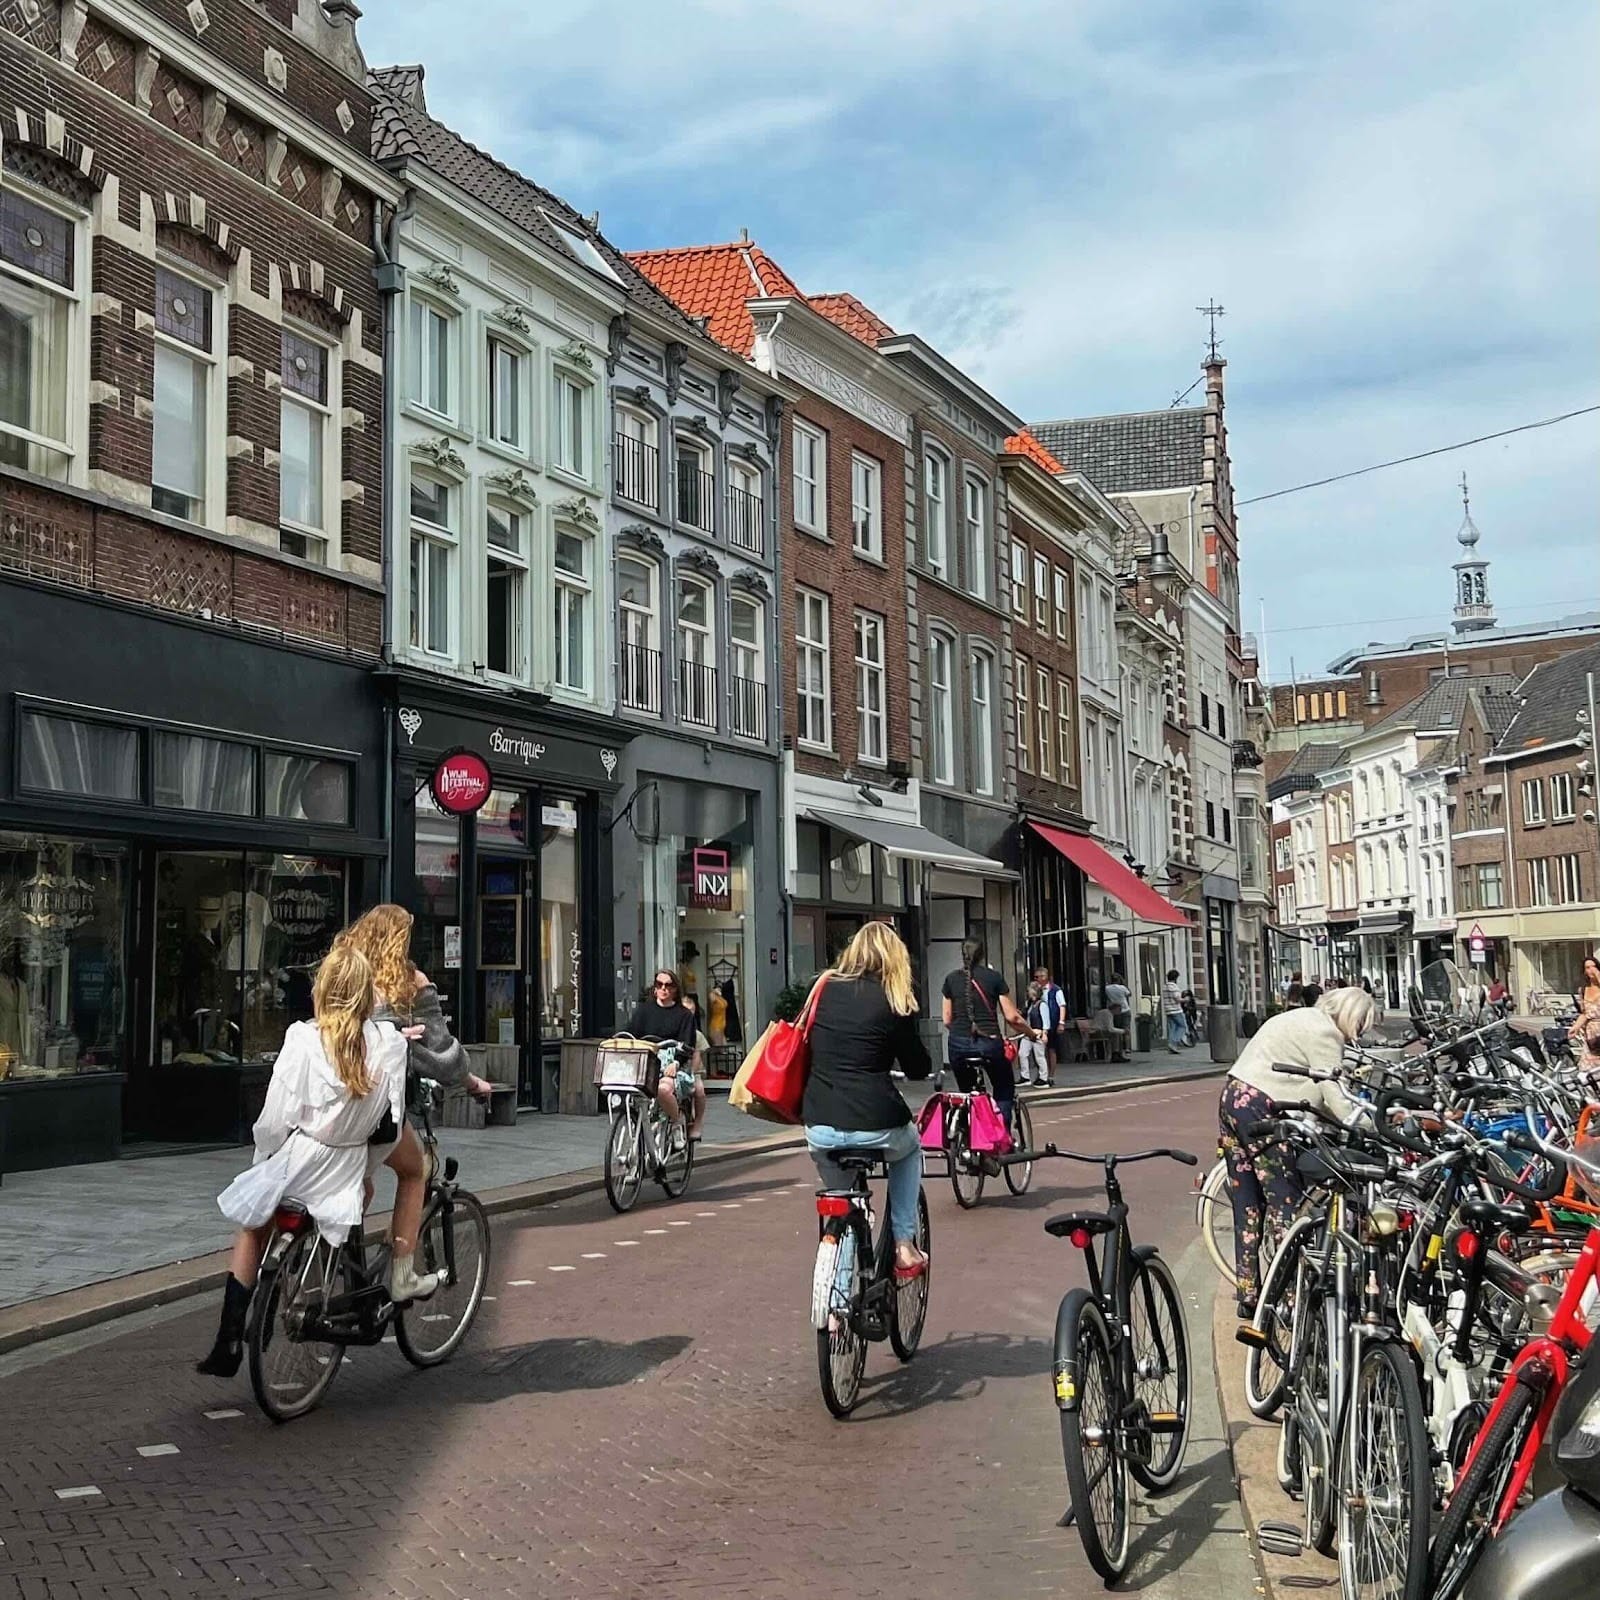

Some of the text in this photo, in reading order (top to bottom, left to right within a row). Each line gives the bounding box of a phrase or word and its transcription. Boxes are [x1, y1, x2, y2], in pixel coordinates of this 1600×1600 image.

[490, 727, 546, 765] Barrique
[449, 769, 468, 778] WIJN
[450, 777, 481, 787] FESTIVAL
[21, 891, 50, 909] HYPE
[273, 903, 294, 920] HYPE
